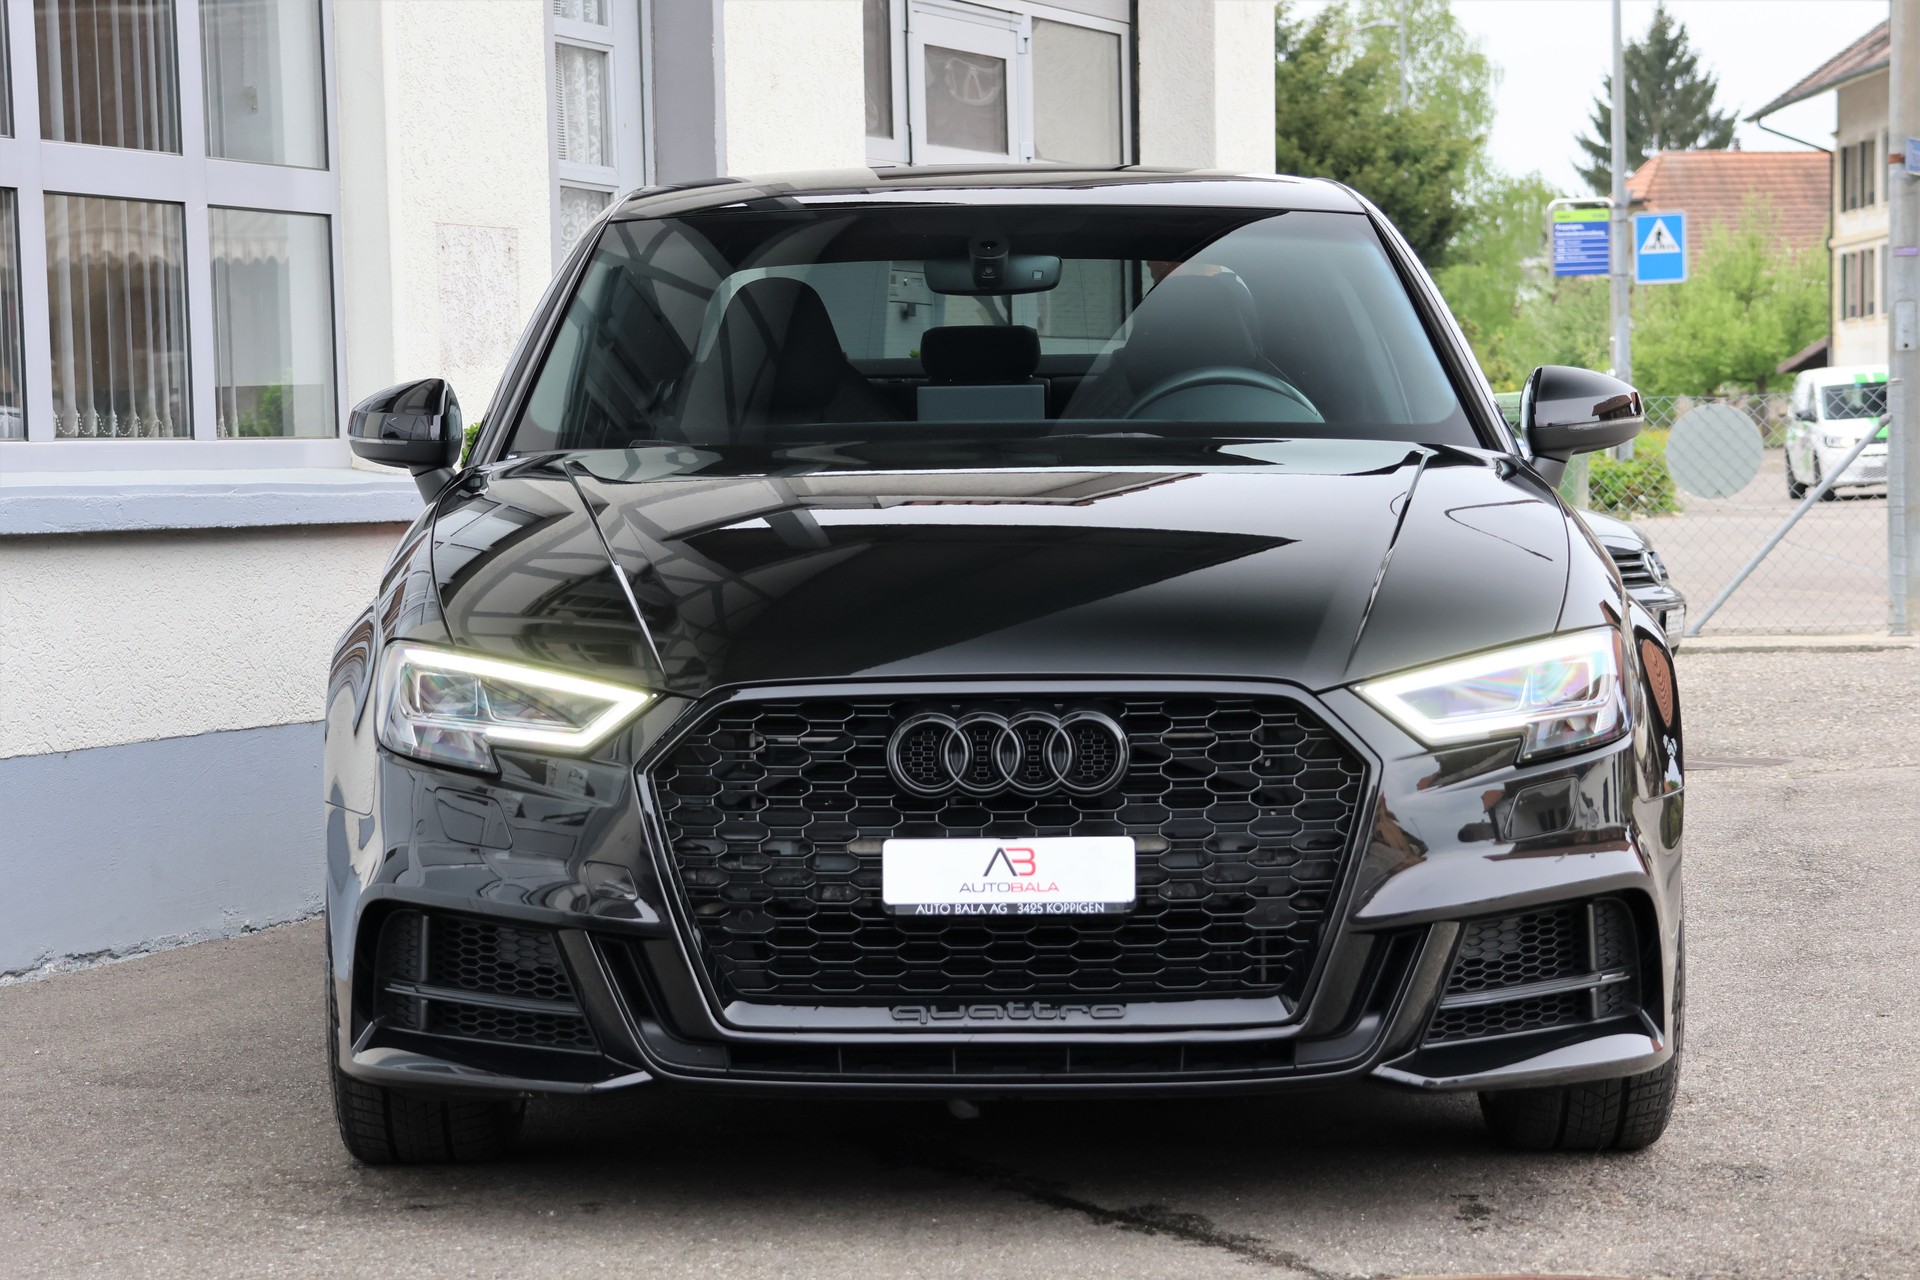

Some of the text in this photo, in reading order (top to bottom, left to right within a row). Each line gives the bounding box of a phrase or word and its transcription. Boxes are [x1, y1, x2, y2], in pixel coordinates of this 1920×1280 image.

[959, 881, 1060, 893] AUTOBALA
[915, 902, 1105, 915] AUTO BALA AG 3425 KOPPIGEN
[891, 1001, 1127, 1025] quattro
